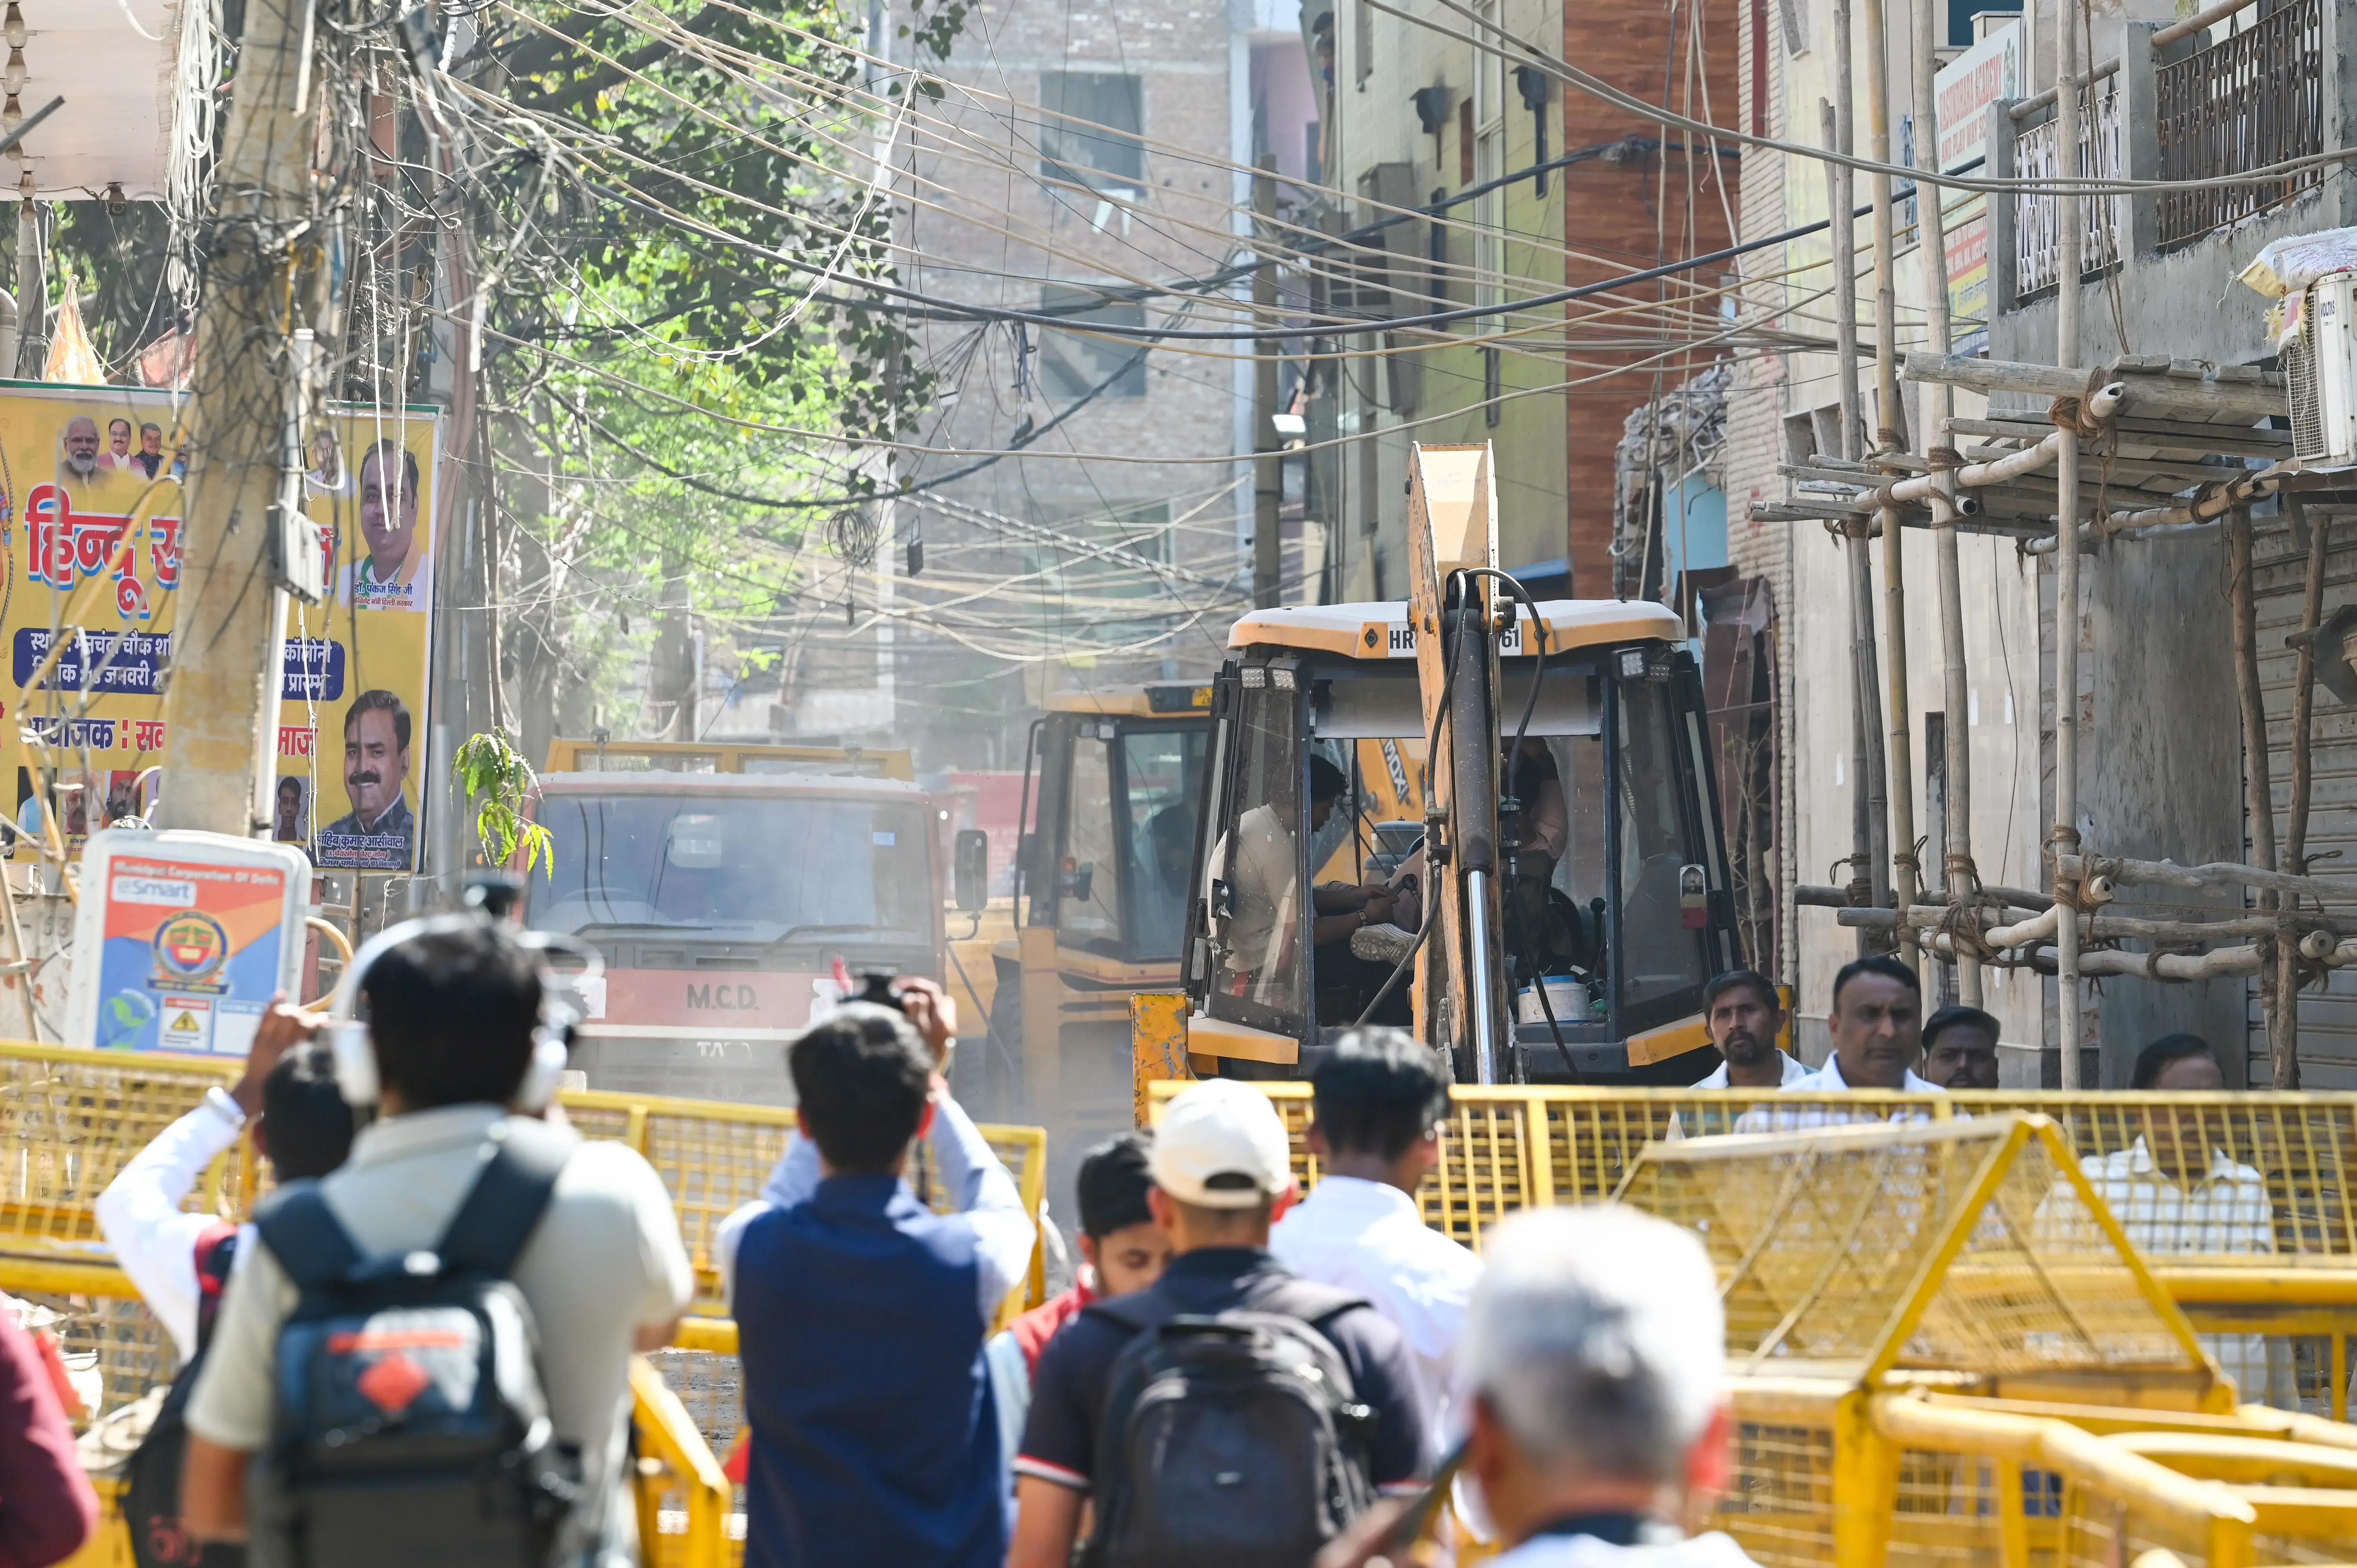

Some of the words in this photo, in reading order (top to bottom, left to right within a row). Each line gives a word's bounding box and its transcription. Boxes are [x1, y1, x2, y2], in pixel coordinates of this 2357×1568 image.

[1939, 71, 1974, 134] VASUNDHARA
[1975, 52, 2002, 110] ACADEMY
[1941, 137, 1951, 165] AND
[1953, 126, 1965, 157] PLAY
[1967, 118, 1978, 148] WAY
[2320, 300, 2335, 318] VOLTAS
[367, 582, 386, 594] पंकज
[388, 582, 402, 595] सिंह
[403, 583, 413, 595] जी
[382, 597, 395, 606] दिल्ली
[123, 629, 153, 656] चौक
[1389, 630, 1414, 649] HR
[104, 660, 150, 687] जनवरी
[278, 725, 319, 757] माज
[340, 833, 366, 850] कुमार
[378, 859, 401, 870] विकासपुरी
[117, 879, 191, 899] eSmart
[687, 983, 761, 1011] M.C.D.
[696, 1041, 753, 1059] TA
